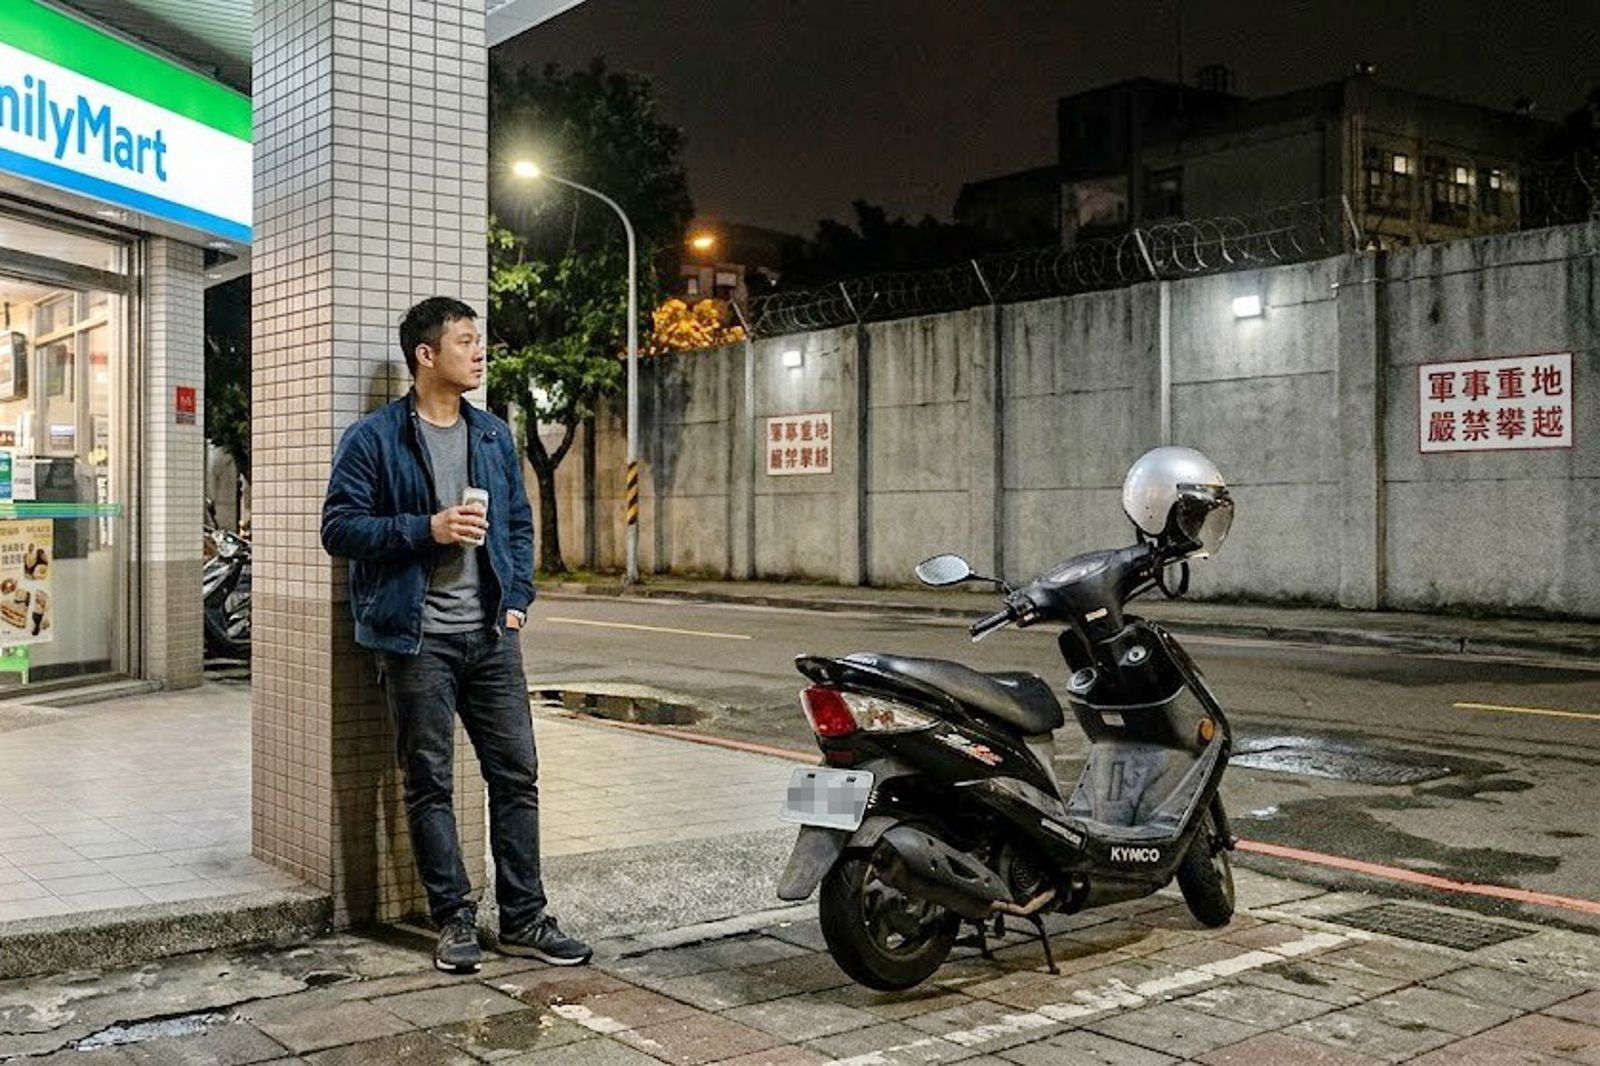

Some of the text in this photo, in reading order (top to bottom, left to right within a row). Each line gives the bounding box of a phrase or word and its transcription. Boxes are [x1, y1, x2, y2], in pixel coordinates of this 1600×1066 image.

[1428, 364, 1564, 403] 軍事重地
[1427, 405, 1564, 443] 嚴禁攀越
